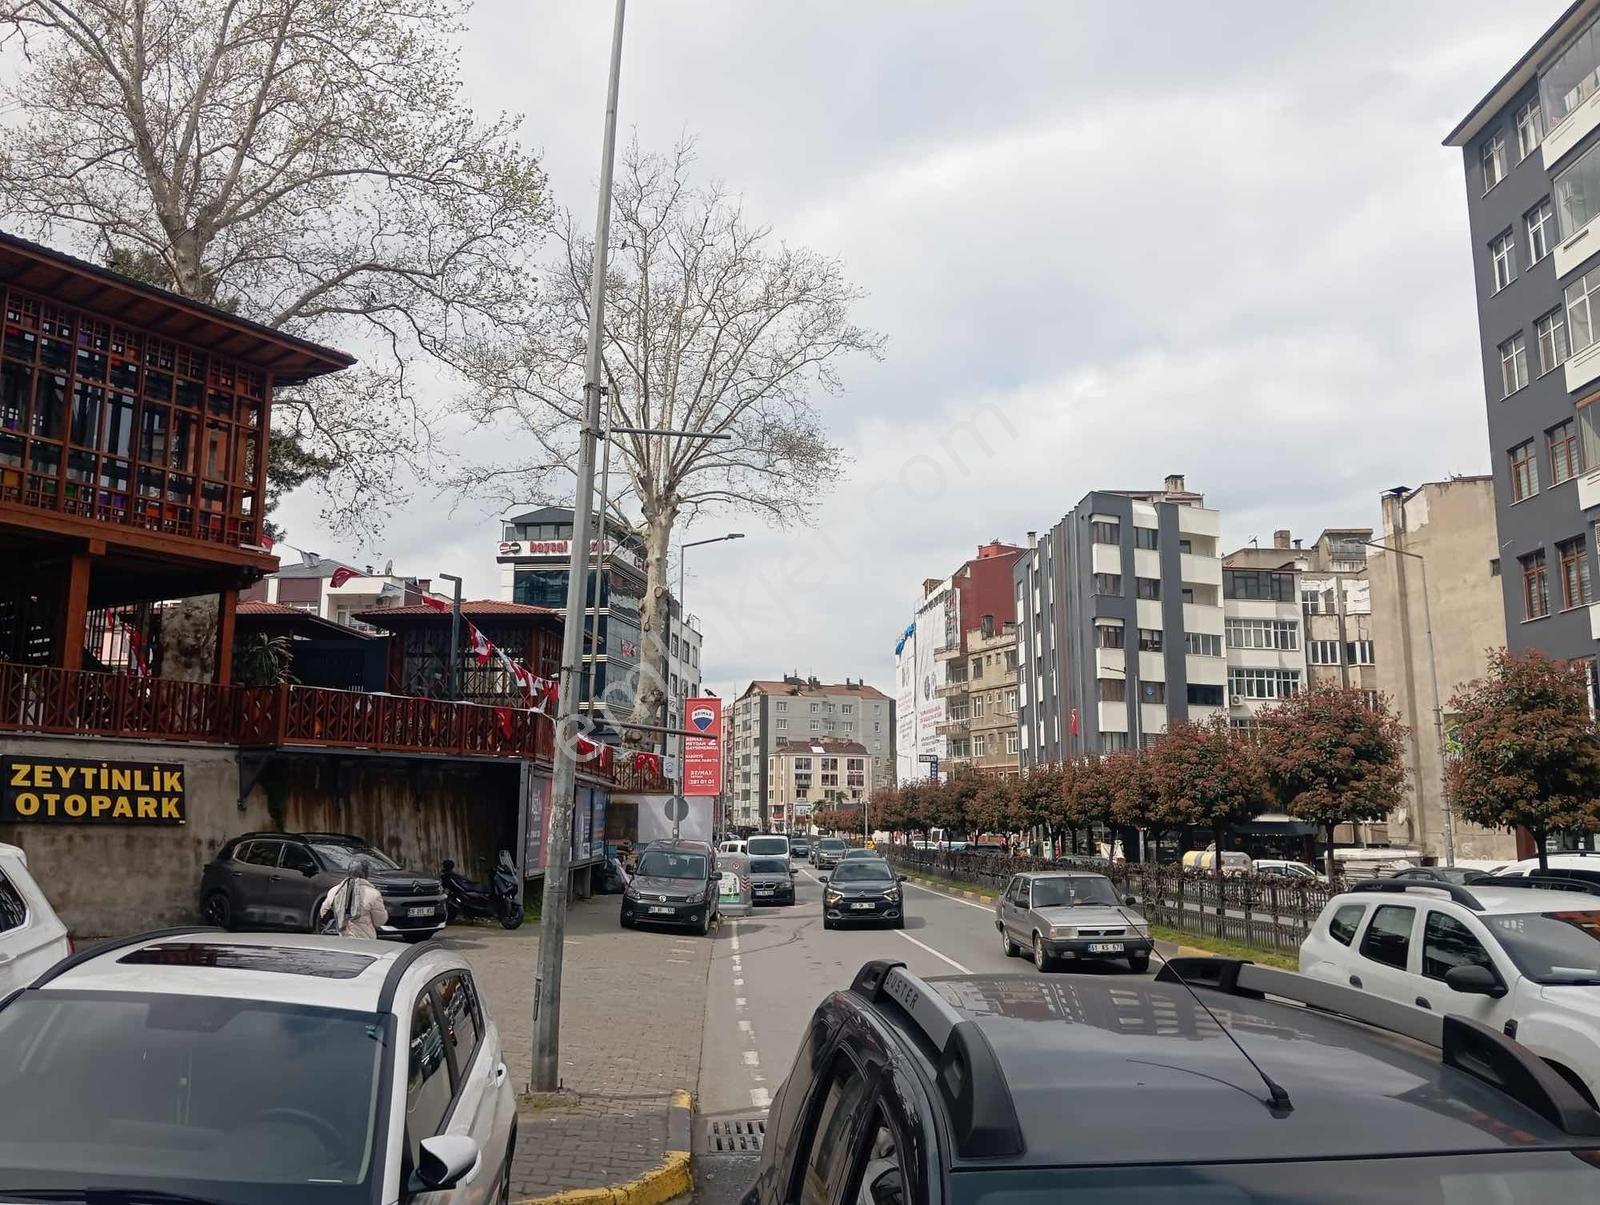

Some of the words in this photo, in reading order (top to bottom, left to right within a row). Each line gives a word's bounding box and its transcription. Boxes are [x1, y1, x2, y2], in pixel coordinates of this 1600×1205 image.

[530, 541, 568, 554] baysal
[11, 763, 183, 792] ZEYTİNLİK
[15, 792, 181, 818] OTOPARK
